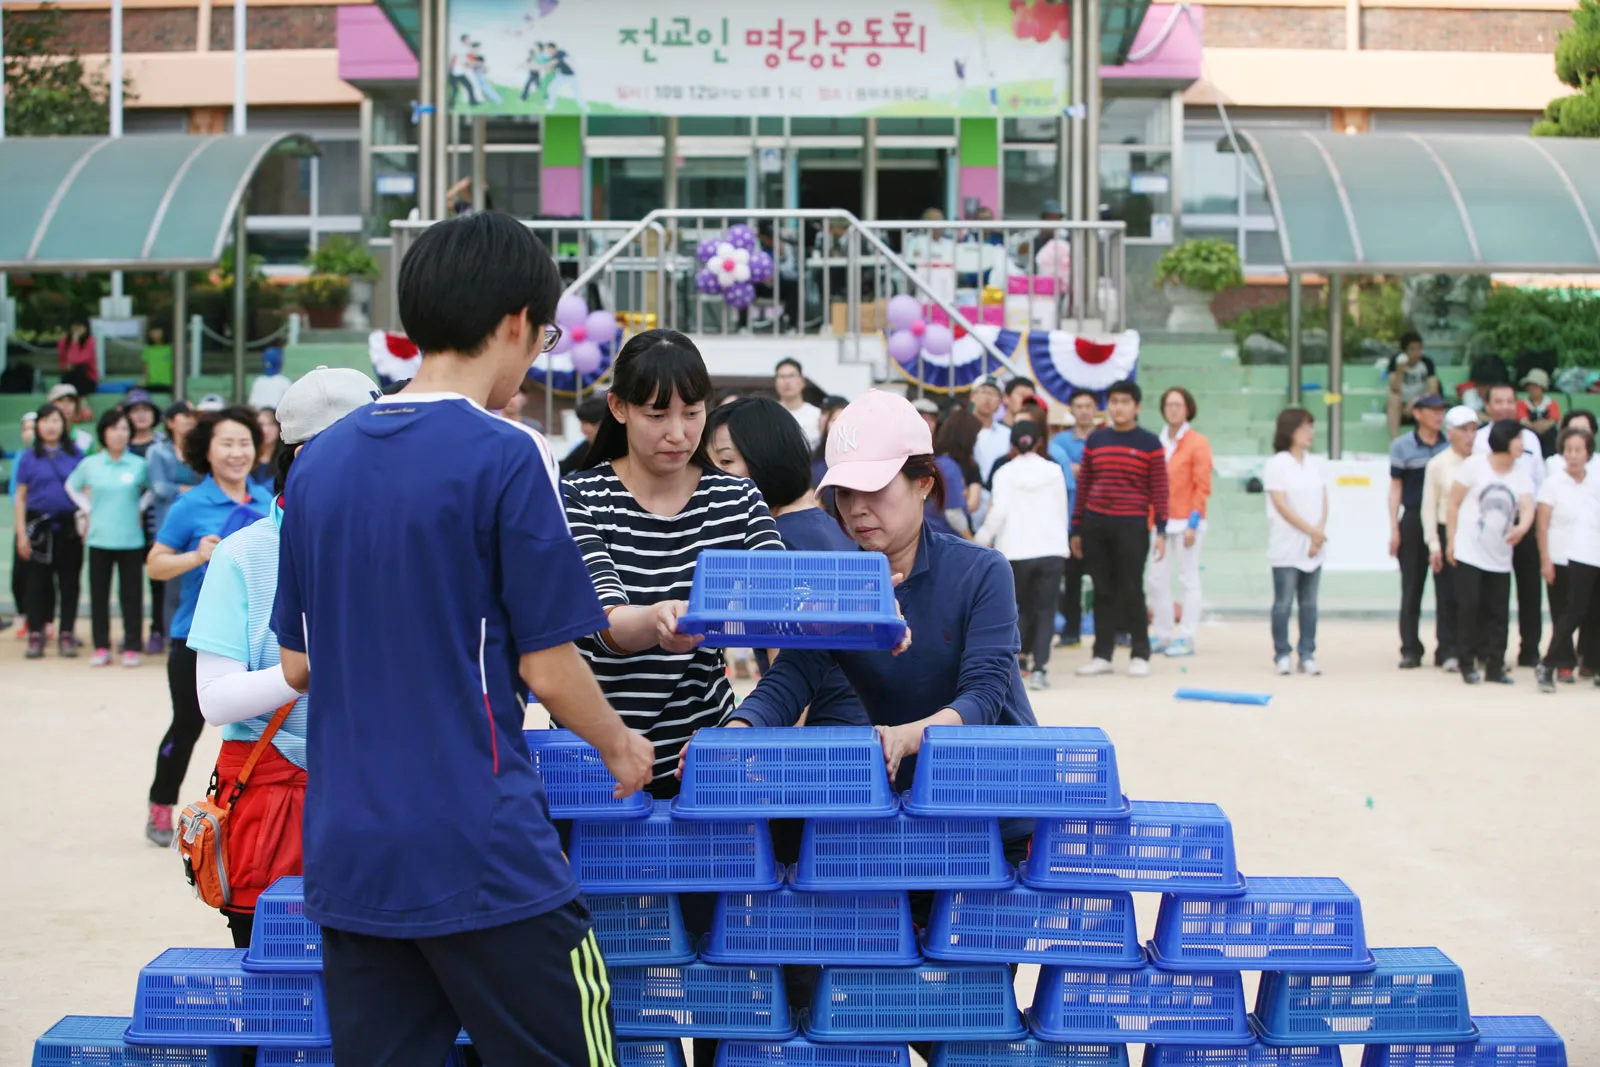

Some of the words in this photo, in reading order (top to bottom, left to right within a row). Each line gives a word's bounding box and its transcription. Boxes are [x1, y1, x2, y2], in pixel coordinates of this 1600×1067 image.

[618, 17, 730, 63] 전교인
[745, 12, 926, 69] 명랑운동회
[655, 85, 684, 99] 10월
[836, 424, 858, 452] NY
